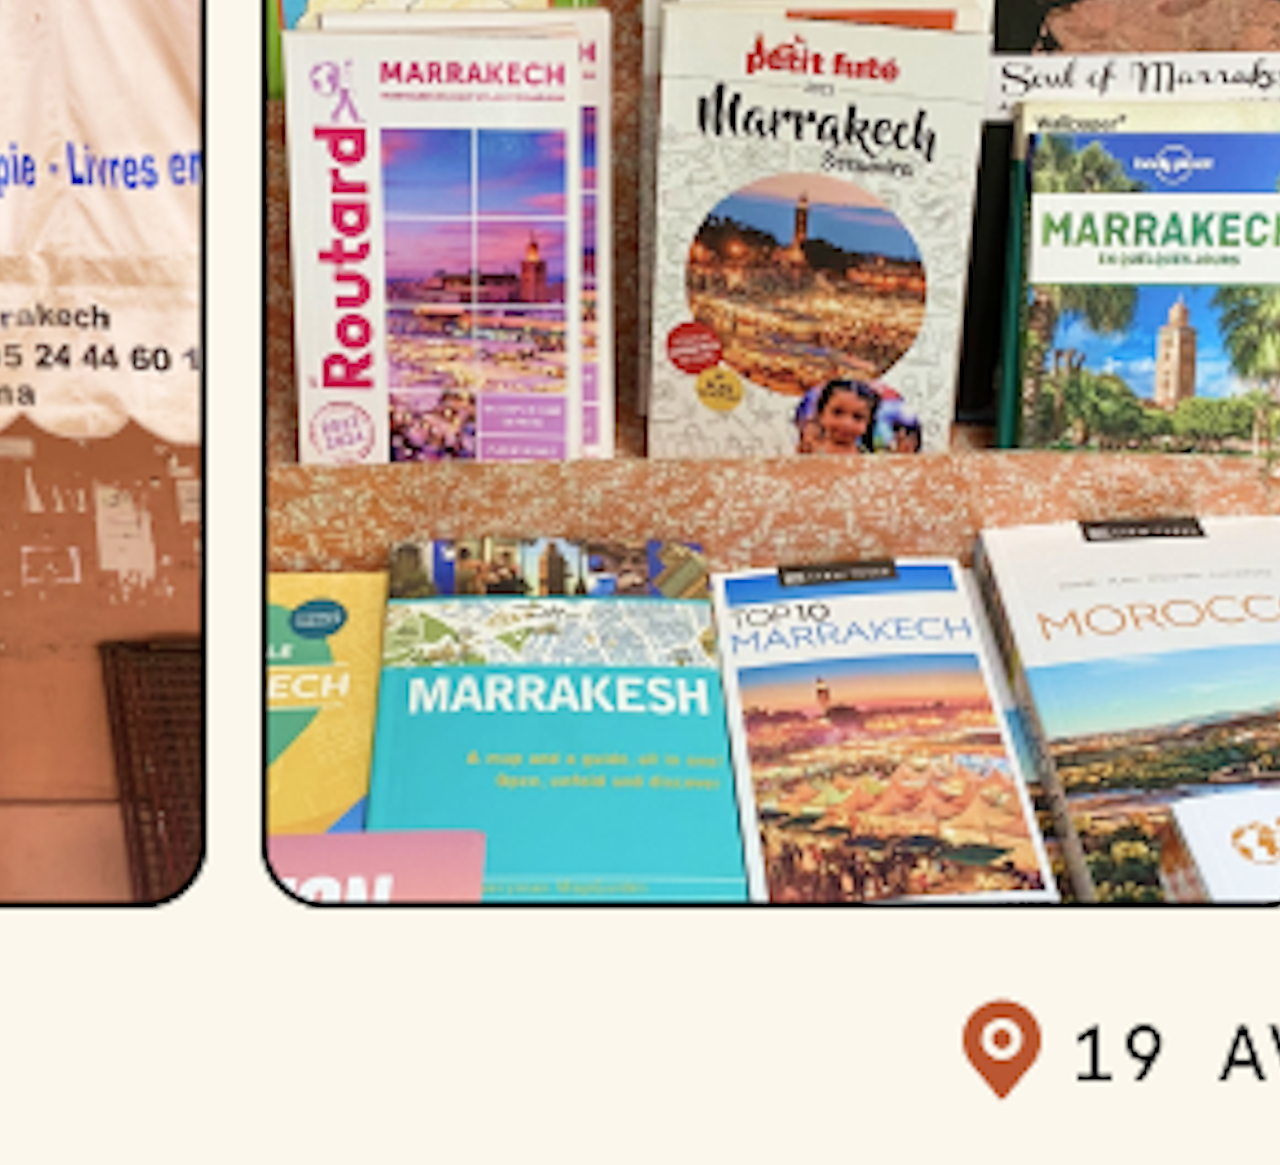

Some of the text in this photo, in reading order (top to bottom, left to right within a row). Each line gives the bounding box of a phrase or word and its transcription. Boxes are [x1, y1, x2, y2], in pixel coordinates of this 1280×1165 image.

[379, 61, 565, 85] MARRAKECH
[1001, 57, 1077, 95] Soul
[1087, 60, 1116, 94] of
[697, 80, 936, 163] Marrakech
[66, 141, 159, 190] Livres
[313, 126, 374, 388] Routard
[35, 343, 71, 369] 24
[81, 344, 121, 371] 44
[731, 615, 973, 655] MARRAKECH
[408, 675, 710, 716] MARRAKESH
